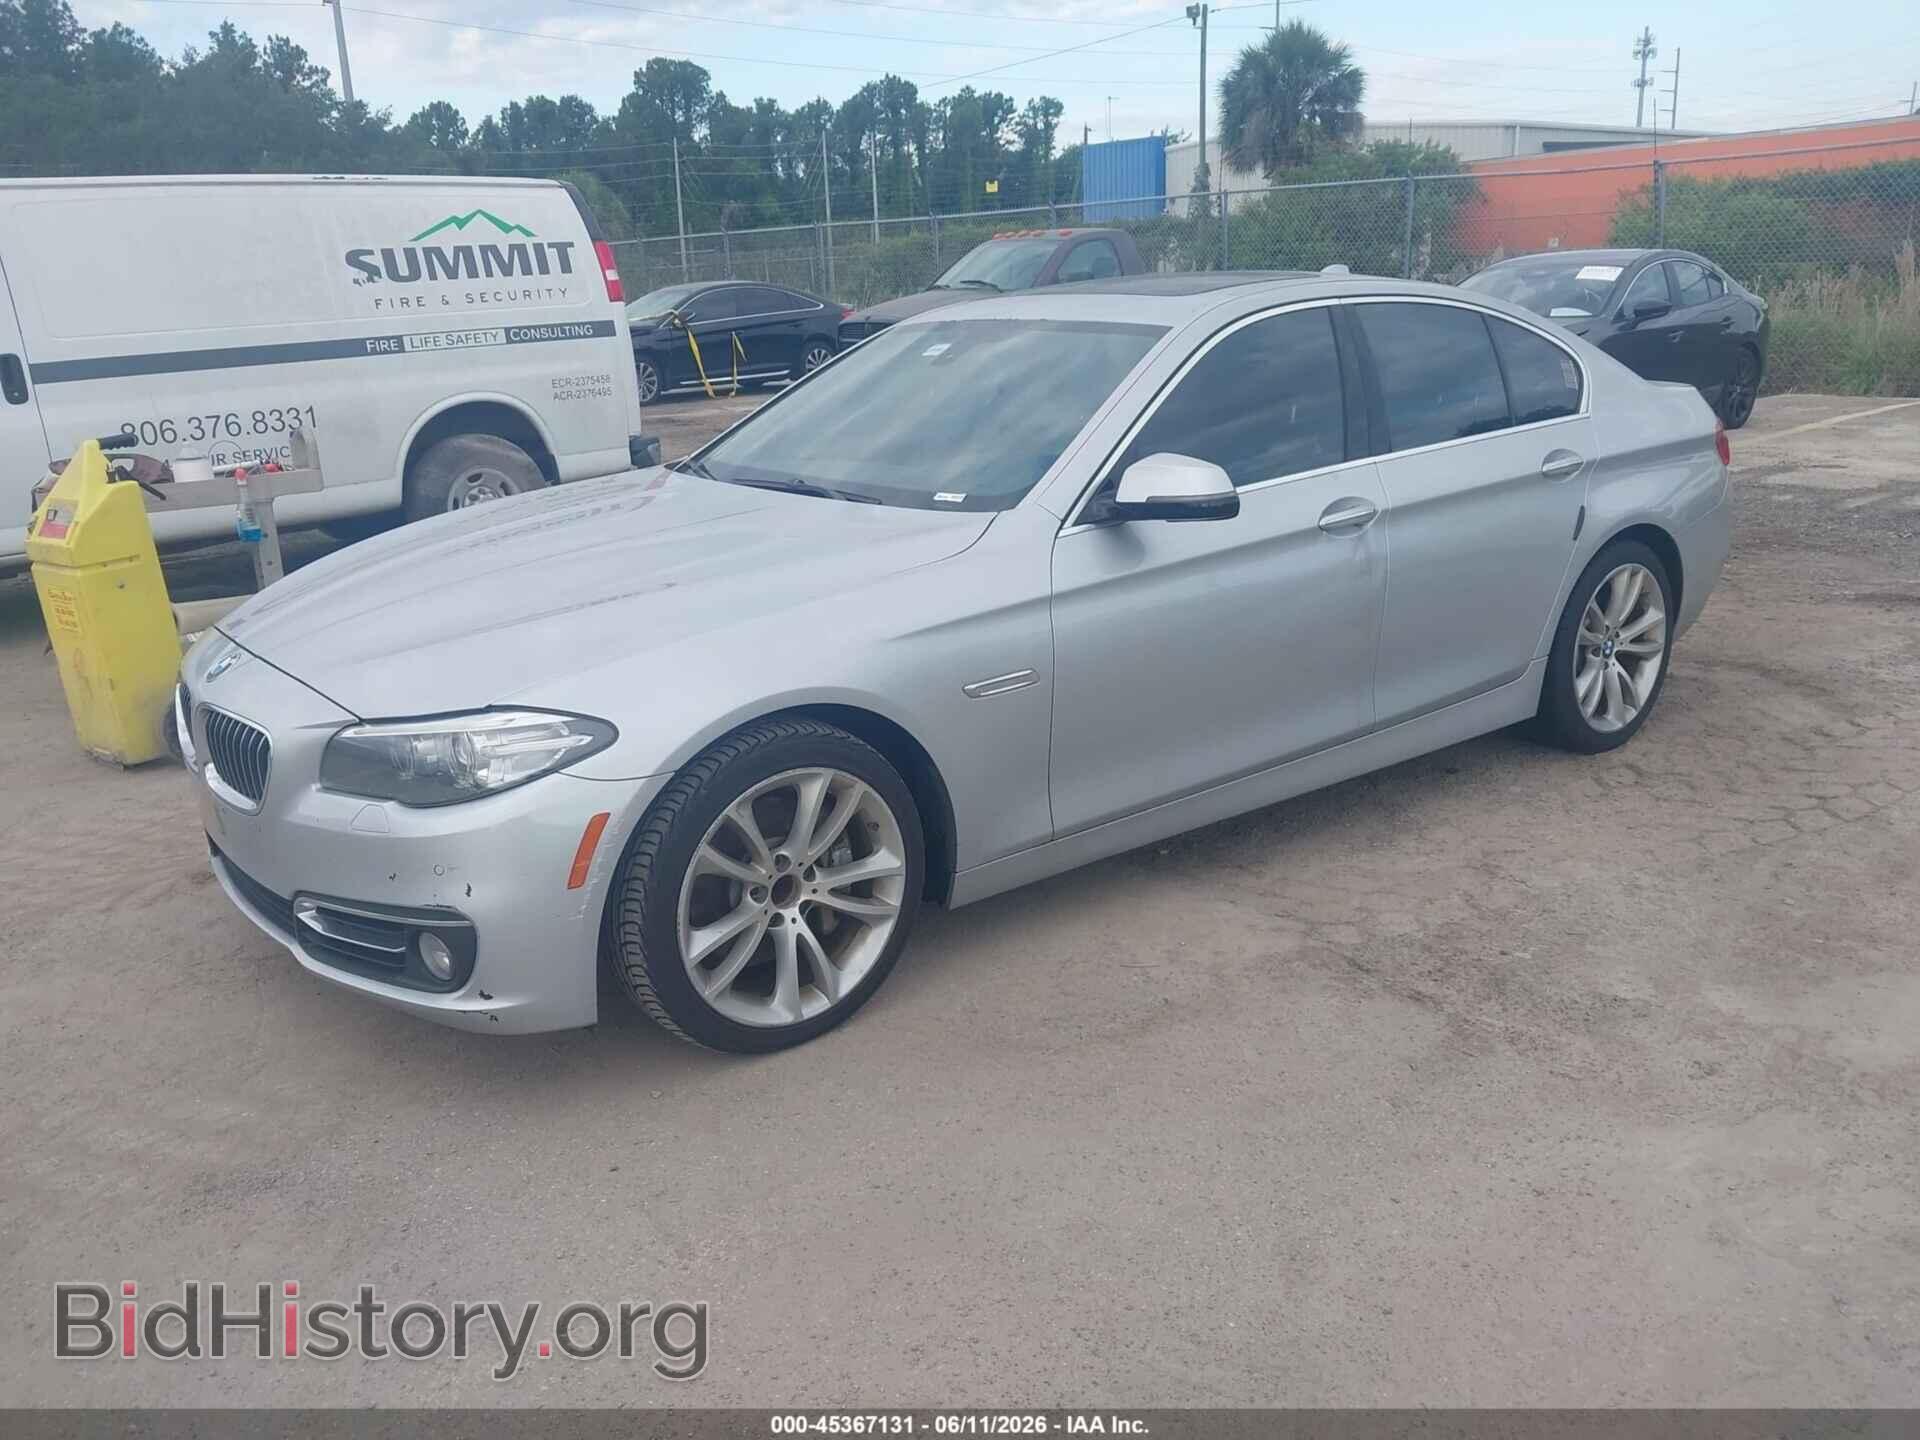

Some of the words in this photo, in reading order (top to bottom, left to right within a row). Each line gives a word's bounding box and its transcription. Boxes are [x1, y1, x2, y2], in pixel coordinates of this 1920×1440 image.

[345, 241, 575, 286] SUMMIT
[375, 296, 426, 310] FIRE
[441, 294, 449, 305] &
[466, 288, 569, 304] SECURITY
[366, 338, 399, 352] FIRE
[410, 335, 441, 349] LIFE
[446, 331, 499, 347] SAFETY
[510, 325, 593, 342] CONSULTING
[121, 405, 317, 446] 806.376.8331
[232, 446, 290, 464] SERVIC
